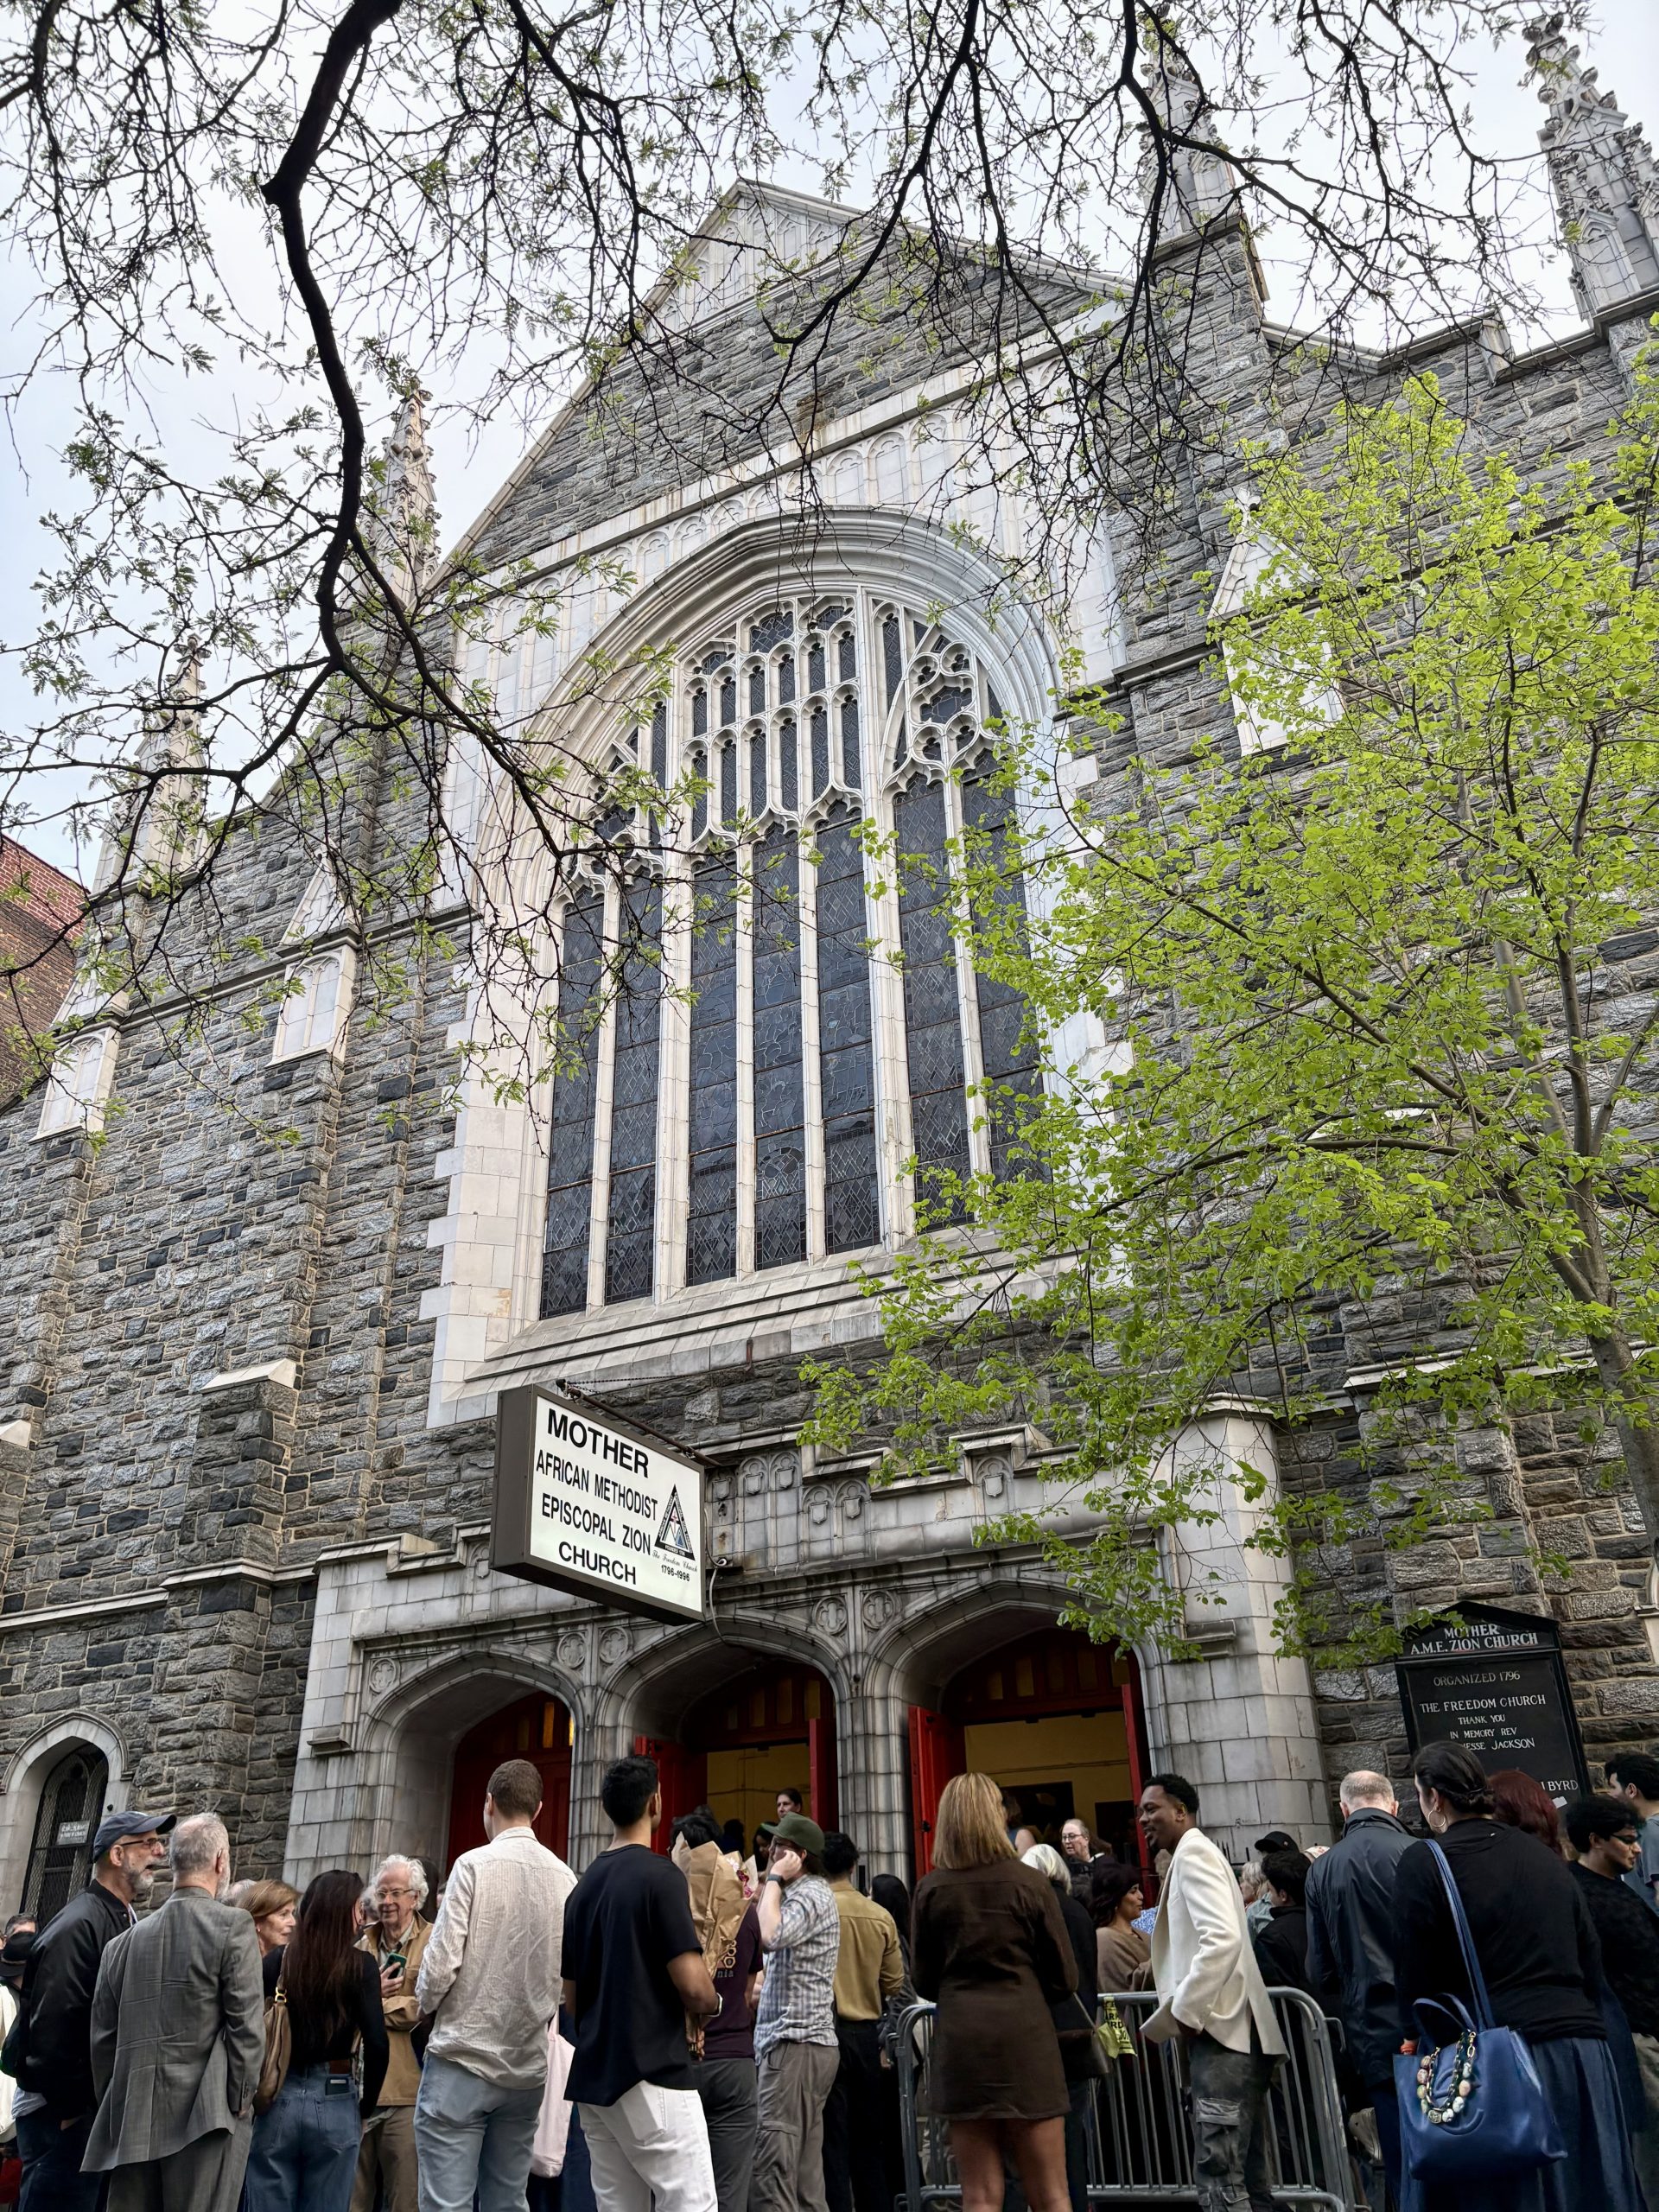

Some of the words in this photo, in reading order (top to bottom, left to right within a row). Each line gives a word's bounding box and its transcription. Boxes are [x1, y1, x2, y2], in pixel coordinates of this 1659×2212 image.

[547, 1408, 650, 1478] MOTHER
[536, 1449, 589, 1493] AFRICAN
[594, 1473, 658, 1521] METHODIST
[542, 1492, 616, 1542] EPISCOPAL
[622, 1524, 652, 1556] ZION
[558, 1541, 637, 1585] CHURCH
[663, 1553, 681, 1567] Freedom
[683, 1560, 697, 1573] Church
[661, 1564, 690, 1582] 1796-1996
[1410, 1639, 1448, 1655] A.M.E.
[1449, 1638, 1481, 1651] ZION
[1484, 1632, 1538, 1649] CHURCH
[1433, 1672, 1496, 1687] ORGANIZED
[1499, 1670, 1521, 1681] 1796
[1420, 1702, 1440, 1713] THE
[1443, 1698, 1497, 1712] FREEDOM
[1500, 1694, 1546, 1707] CHURCH
[1458, 1715, 1487, 1726] THANK
[1490, 1714, 1506, 1723] YOU
[1450, 1731, 1459, 1739] IN
[1464, 1728, 1495, 1738] MEMORY
[1501, 1727, 1517, 1736] REV
[1491, 1738, 1535, 1750] JACKSON
[1547, 1779, 1579, 1791] BYRD
